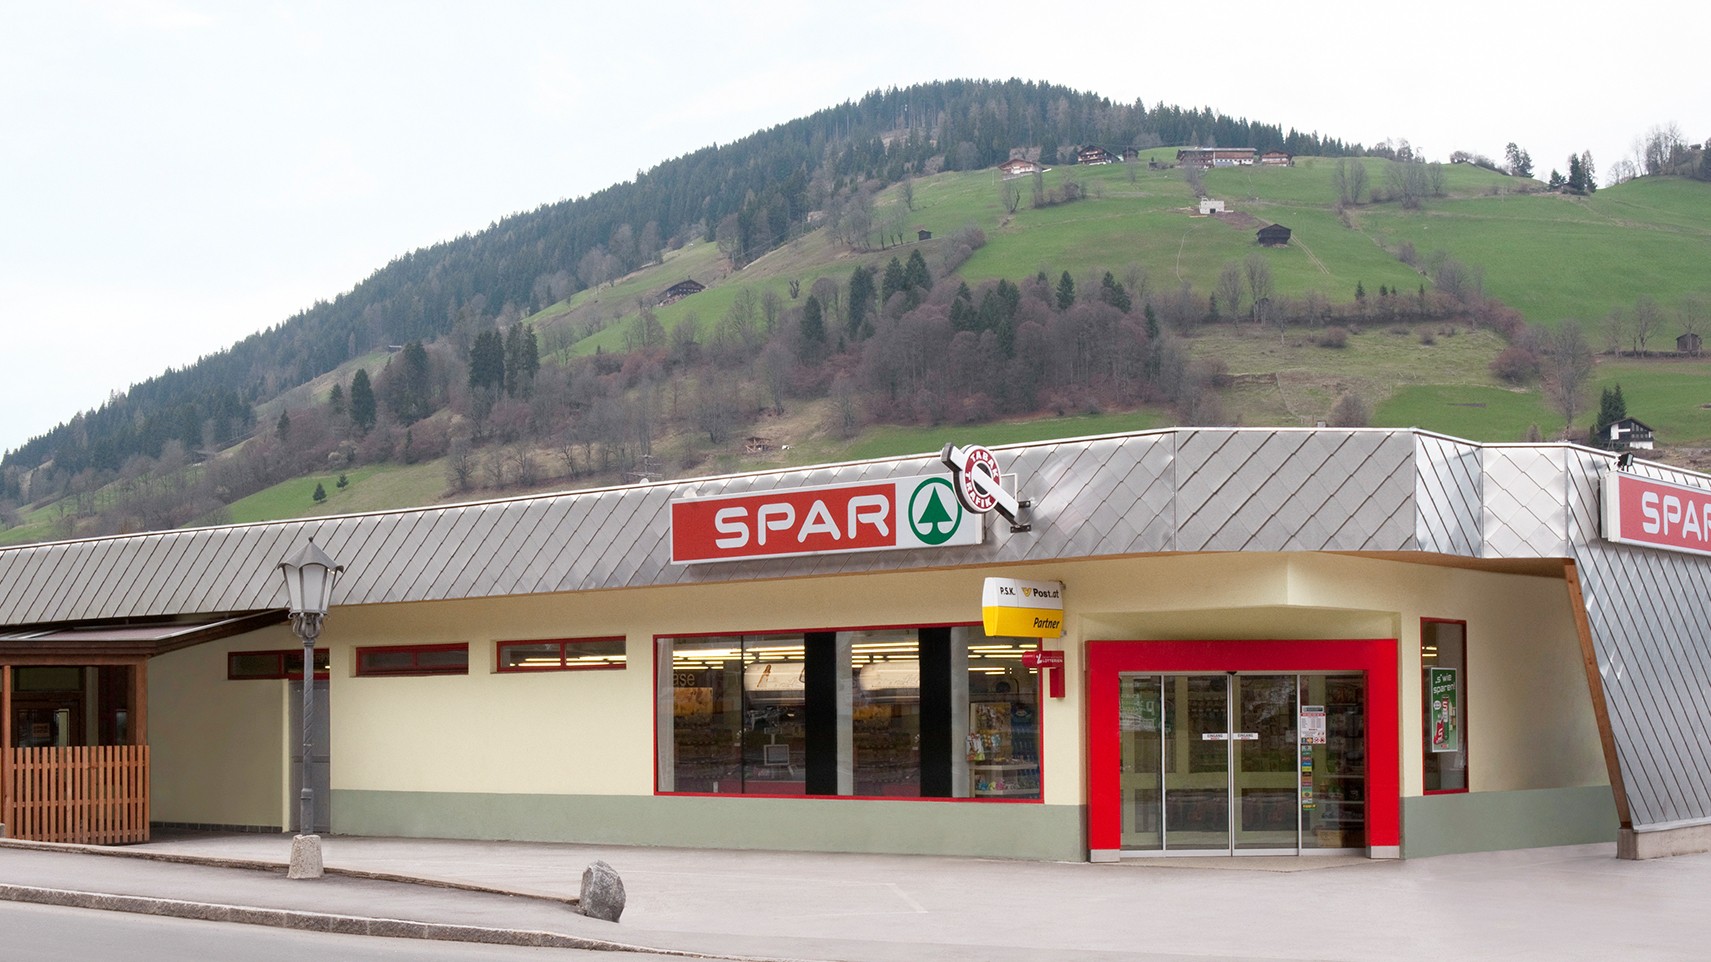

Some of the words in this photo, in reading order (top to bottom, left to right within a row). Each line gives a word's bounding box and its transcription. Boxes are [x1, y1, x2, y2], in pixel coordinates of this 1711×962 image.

[970, 450, 998, 478] TABAK
[965, 471, 992, 508] TRAFIK
[714, 494, 890, 549] SPAR
[1000, 586, 1016, 596] P.S.K.
[1033, 588, 1060, 598] Post.at
[1033, 616, 1060, 629] Partner
